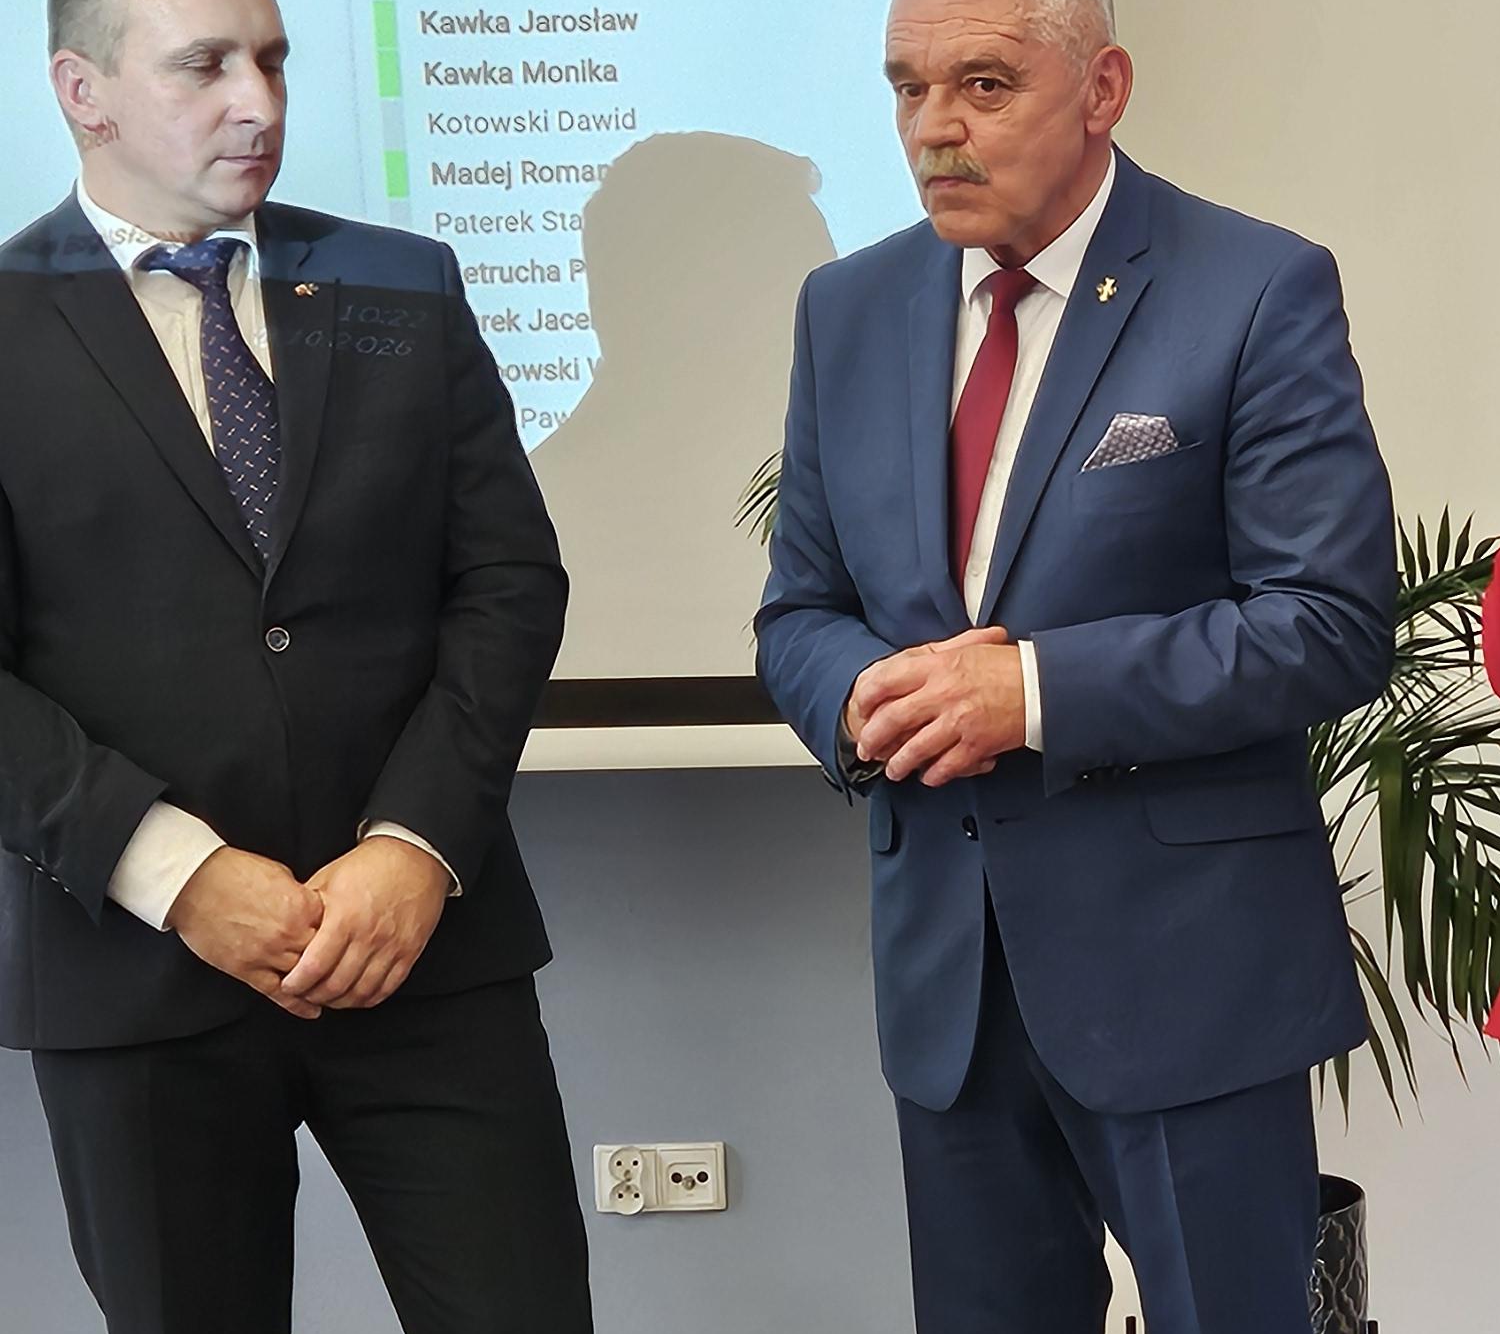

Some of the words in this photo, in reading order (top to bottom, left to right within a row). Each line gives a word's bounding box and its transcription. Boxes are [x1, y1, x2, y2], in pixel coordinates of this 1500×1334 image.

[419, 9, 511, 35] Kawka
[518, 7, 639, 34] Jarosław
[423, 59, 514, 86] Kawka
[522, 58, 618, 84] Monika
[428, 109, 549, 135] Kotowski
[558, 108, 637, 132] Dawid
[431, 160, 513, 191] Madej
[435, 210, 535, 235] Paterek
